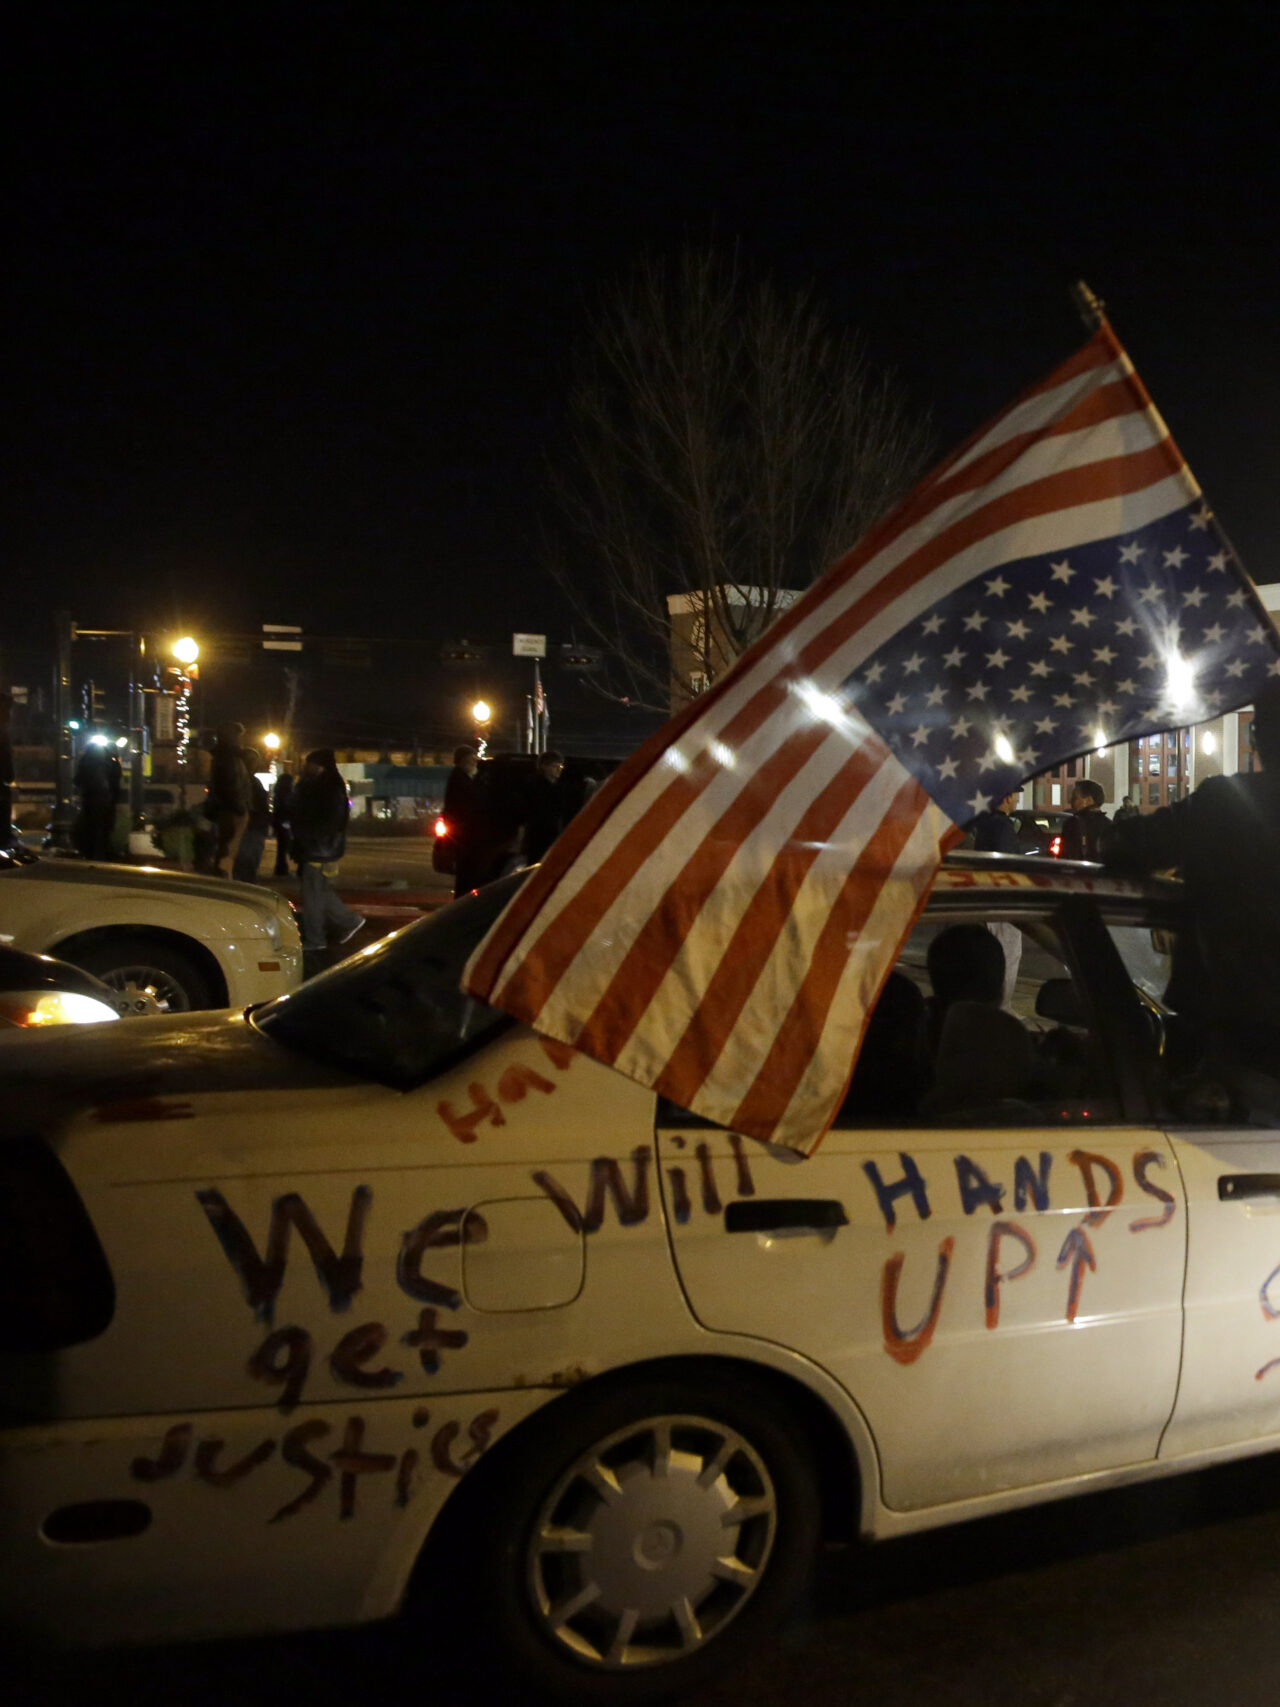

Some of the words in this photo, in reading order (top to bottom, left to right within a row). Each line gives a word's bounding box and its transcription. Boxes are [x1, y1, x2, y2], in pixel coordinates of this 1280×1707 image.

[195, 1185, 488, 1322] We
[532, 1134, 755, 1234] Will
[861, 1150, 1176, 1235] HANDS
[881, 1221, 1037, 1364] UP
[247, 1307, 468, 1414] get
